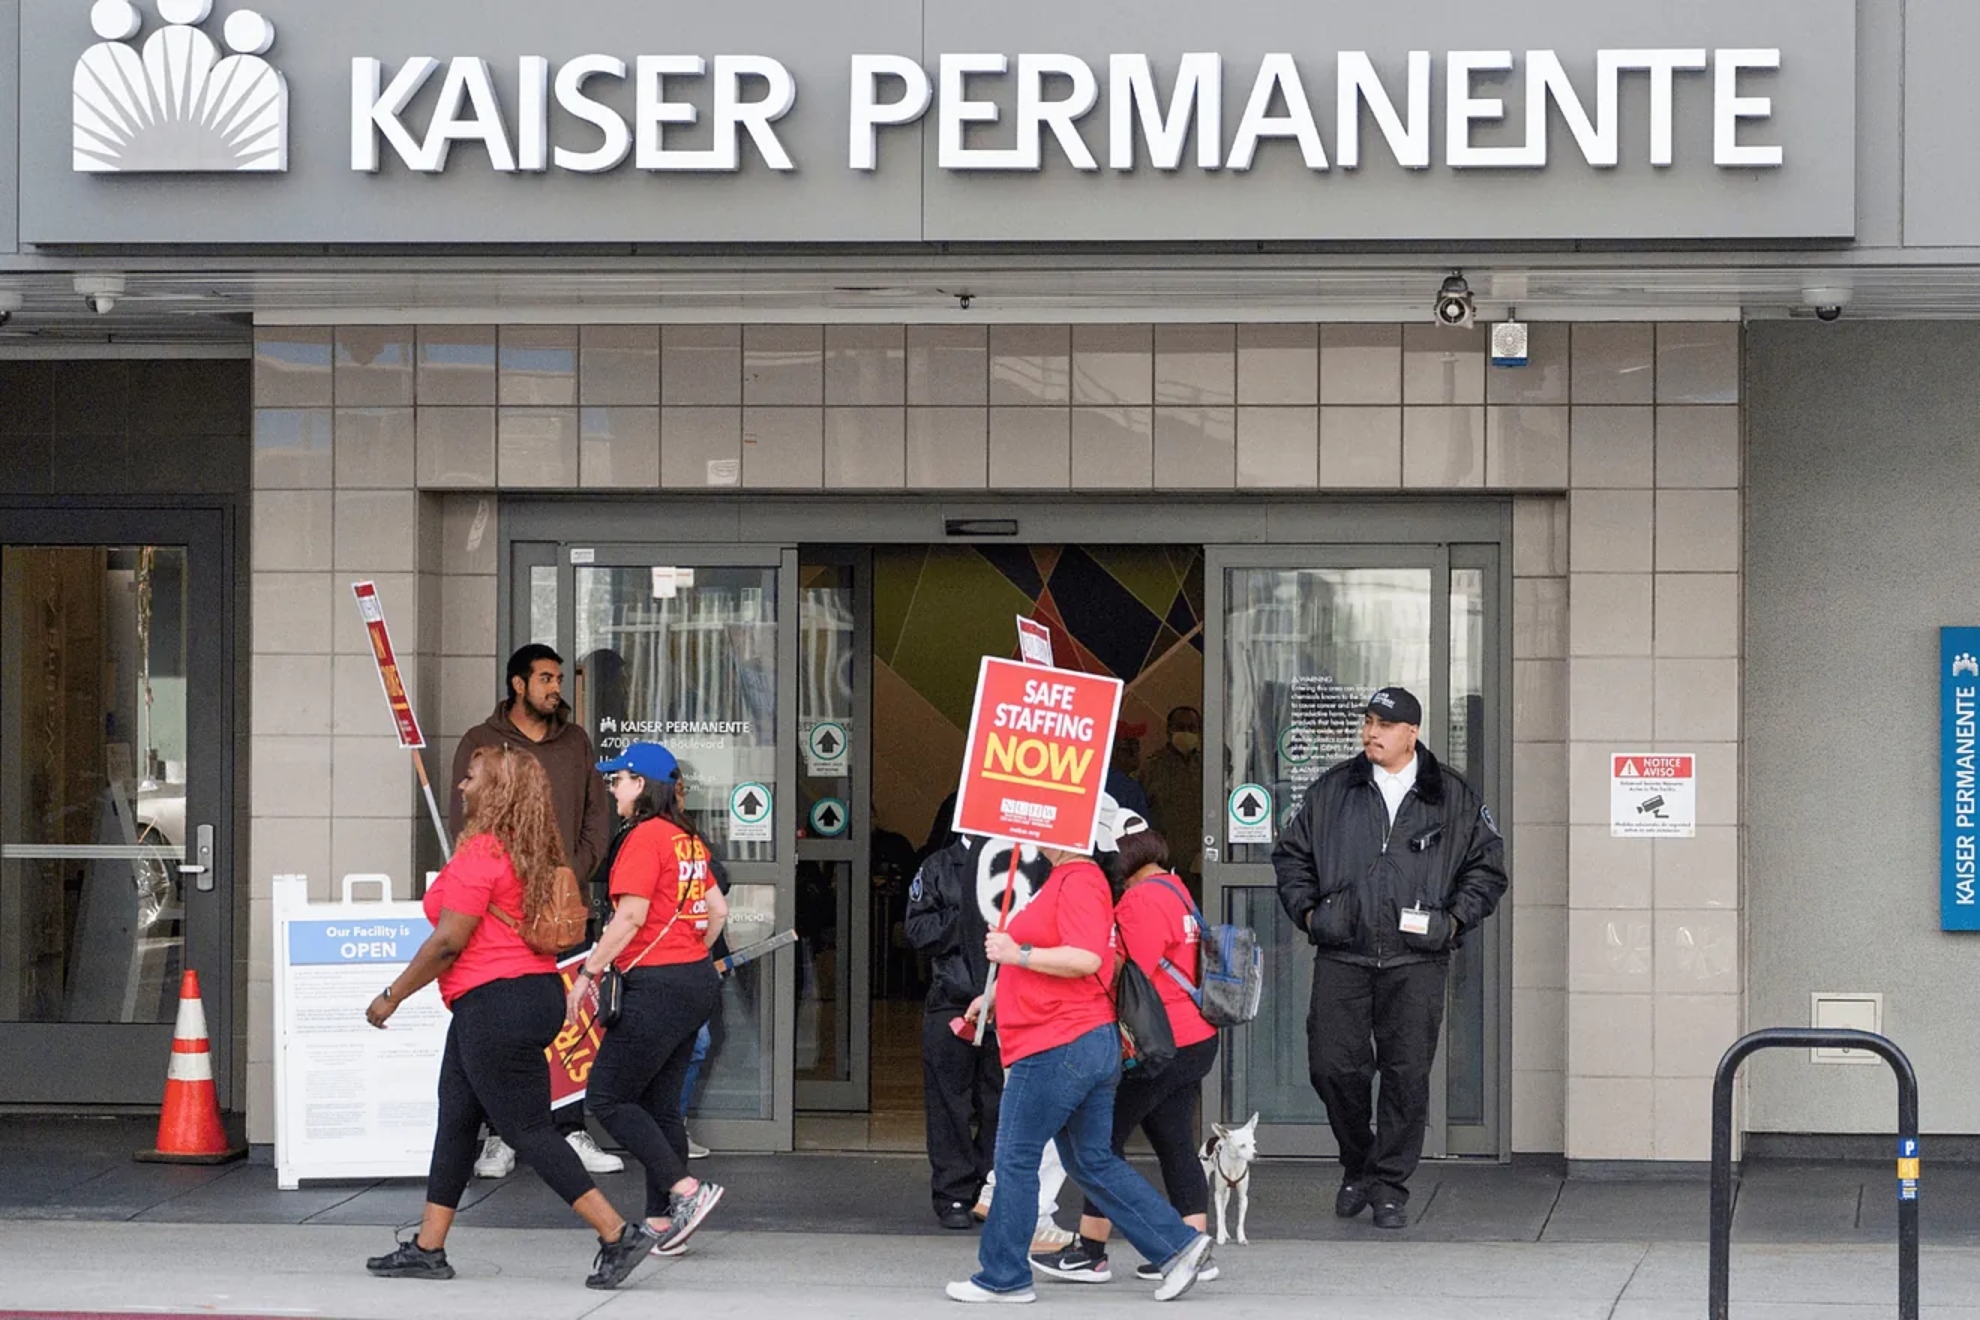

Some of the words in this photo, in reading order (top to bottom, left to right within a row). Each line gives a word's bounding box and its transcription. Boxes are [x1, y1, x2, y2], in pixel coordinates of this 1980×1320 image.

[350, 54, 796, 174] KAISER
[850, 47, 1784, 171] PERMANENTE
[1022, 679, 1076, 711] SAFE
[620, 720, 662, 733] KAISER
[666, 720, 751, 733] PERMANENTE
[993, 702, 1095, 742] STAFFING
[600, 737, 630, 749] 4700
[983, 732, 1095, 784] NOW
[1643, 757, 1681, 768] NOTICE
[1955, 686, 1975, 828] PERMANENTE
[1643, 767, 1675, 777] AVISO
[1955, 836, 1975, 905] KAISER
[326, 925, 352, 938] Our
[353, 925, 398, 939] Facility
[400, 925, 410, 937] is
[340, 942, 397, 959] OPEN
